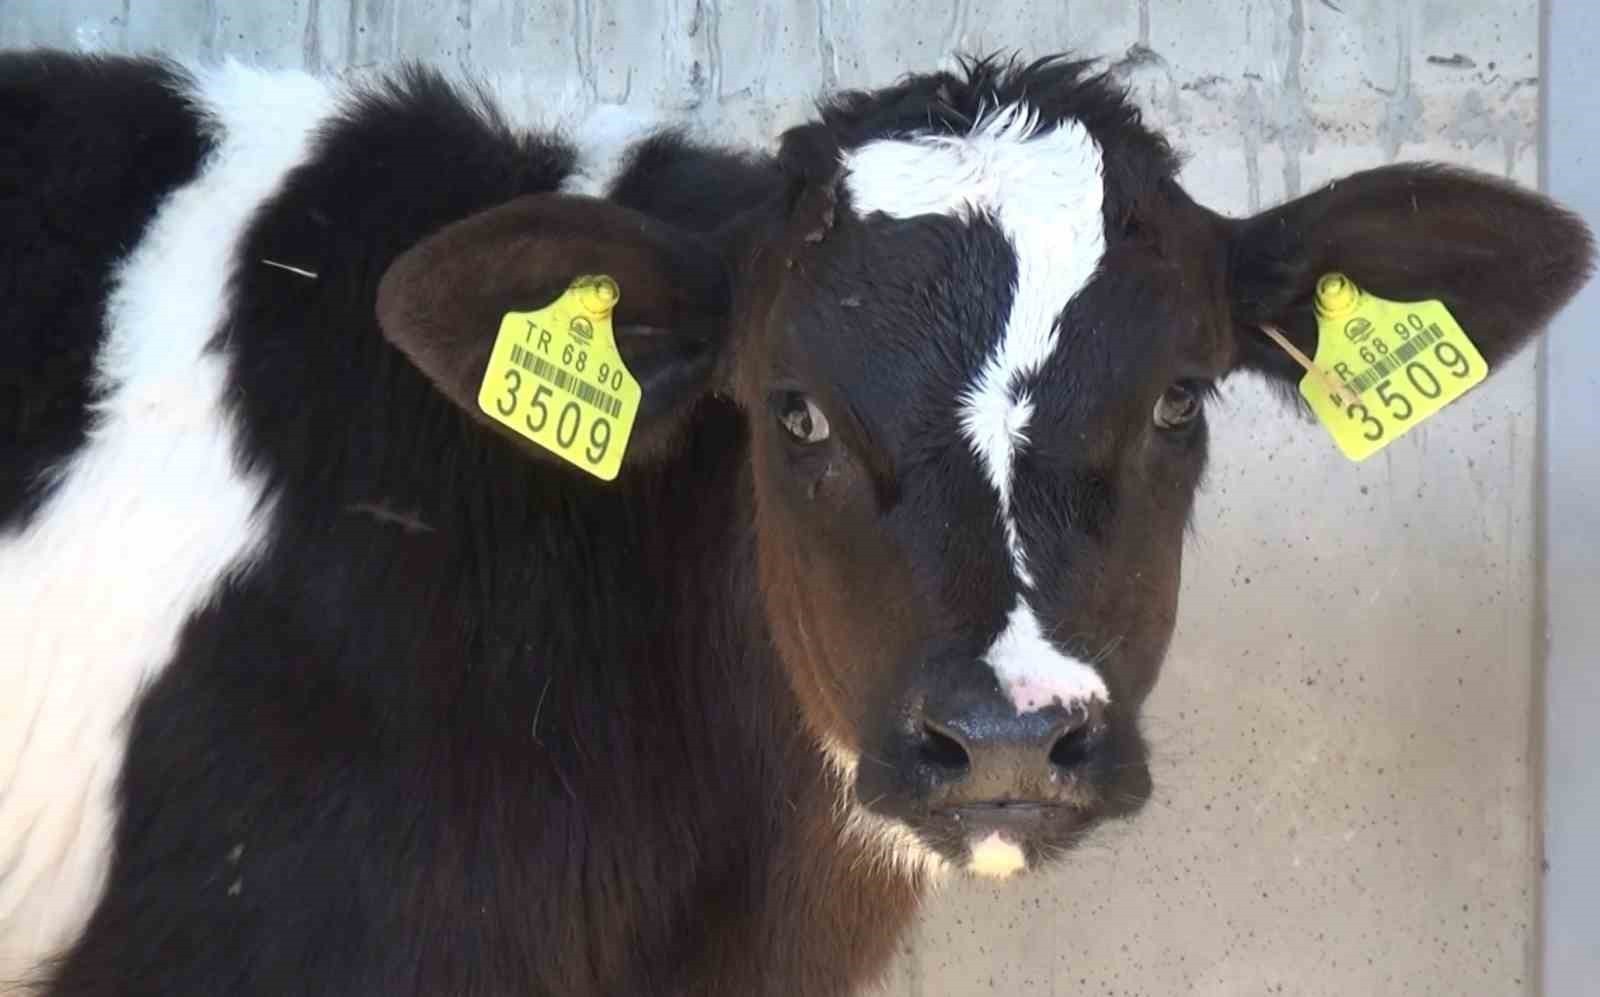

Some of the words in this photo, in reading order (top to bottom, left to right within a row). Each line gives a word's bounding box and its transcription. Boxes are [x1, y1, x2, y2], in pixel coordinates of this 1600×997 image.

[526, 320, 552, 355] TR
[562, 344, 588, 372] 68
[598, 363, 623, 391] 90
[1359, 338, 1389, 364] 68
[1393, 313, 1423, 340] 90
[496, 369, 611, 465] 3509
[1346, 341, 1470, 441] 3509
